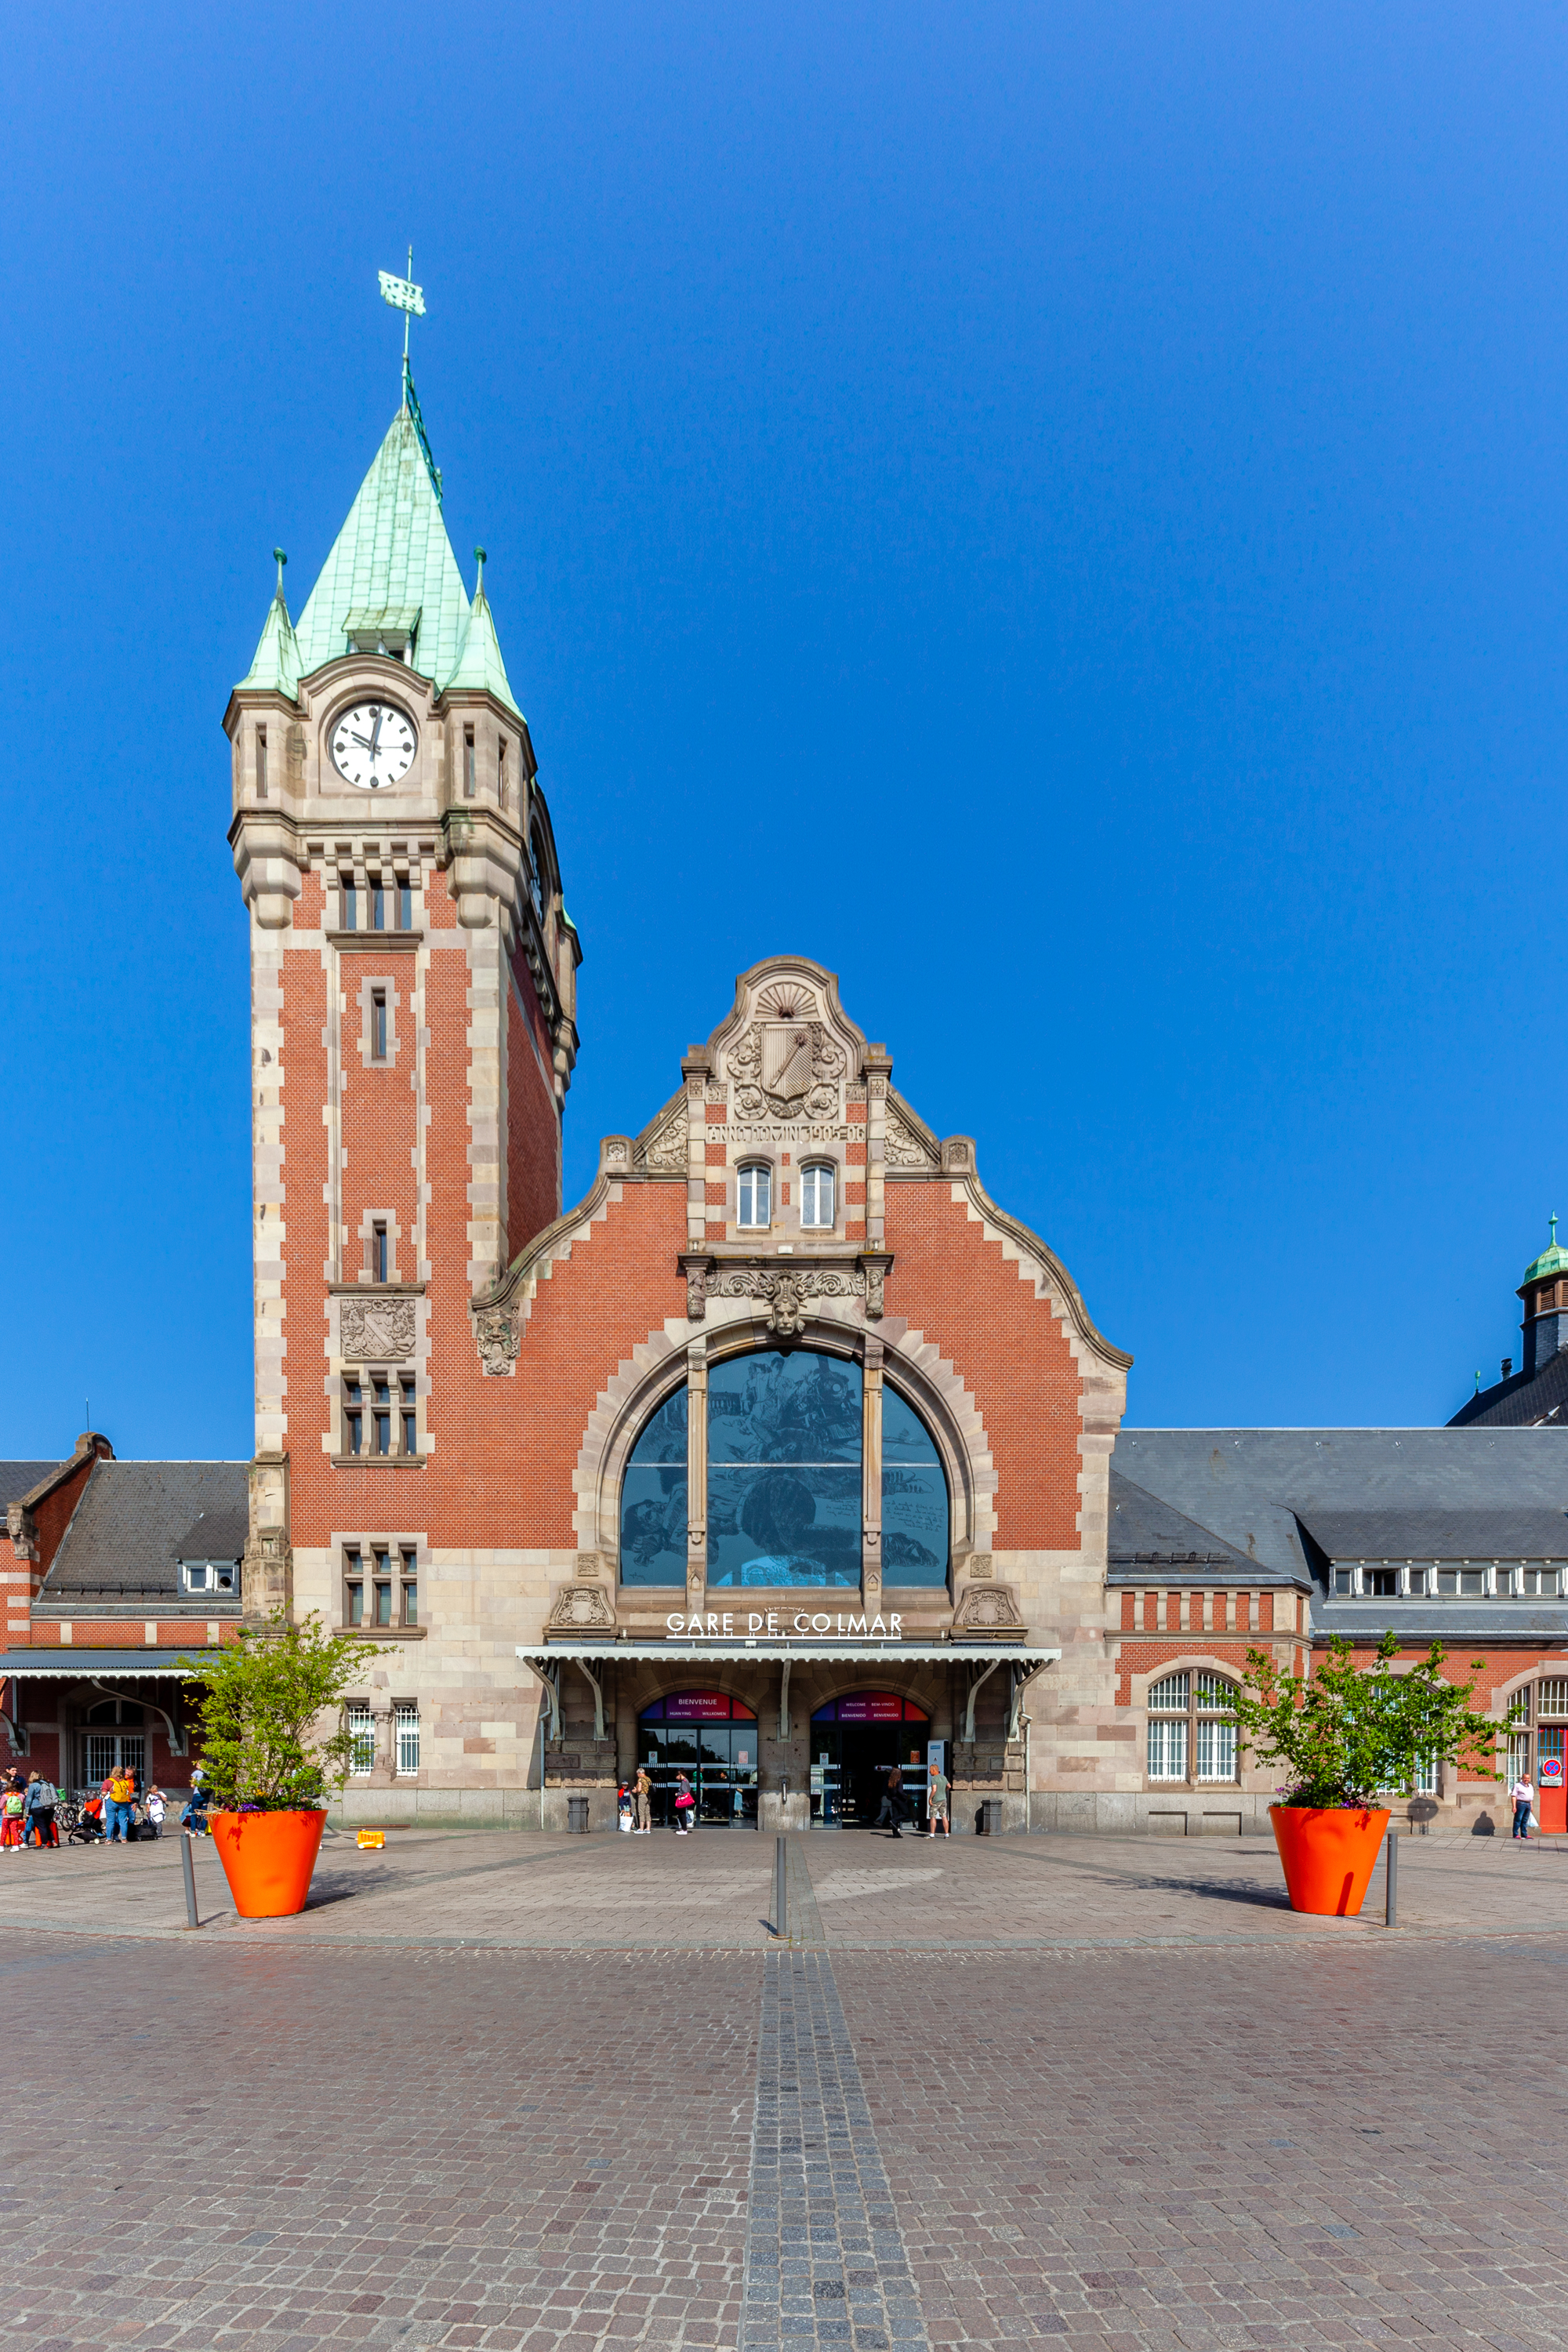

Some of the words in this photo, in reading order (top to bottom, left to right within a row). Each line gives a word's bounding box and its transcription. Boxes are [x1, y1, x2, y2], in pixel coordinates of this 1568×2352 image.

[708, 1126, 746, 1141] ANNO
[751, 1126, 801, 1141] DOMINI
[666, 1613, 734, 1632] GARE
[749, 1613, 779, 1632] DE
[793, 1613, 902, 1632] COLMAR
